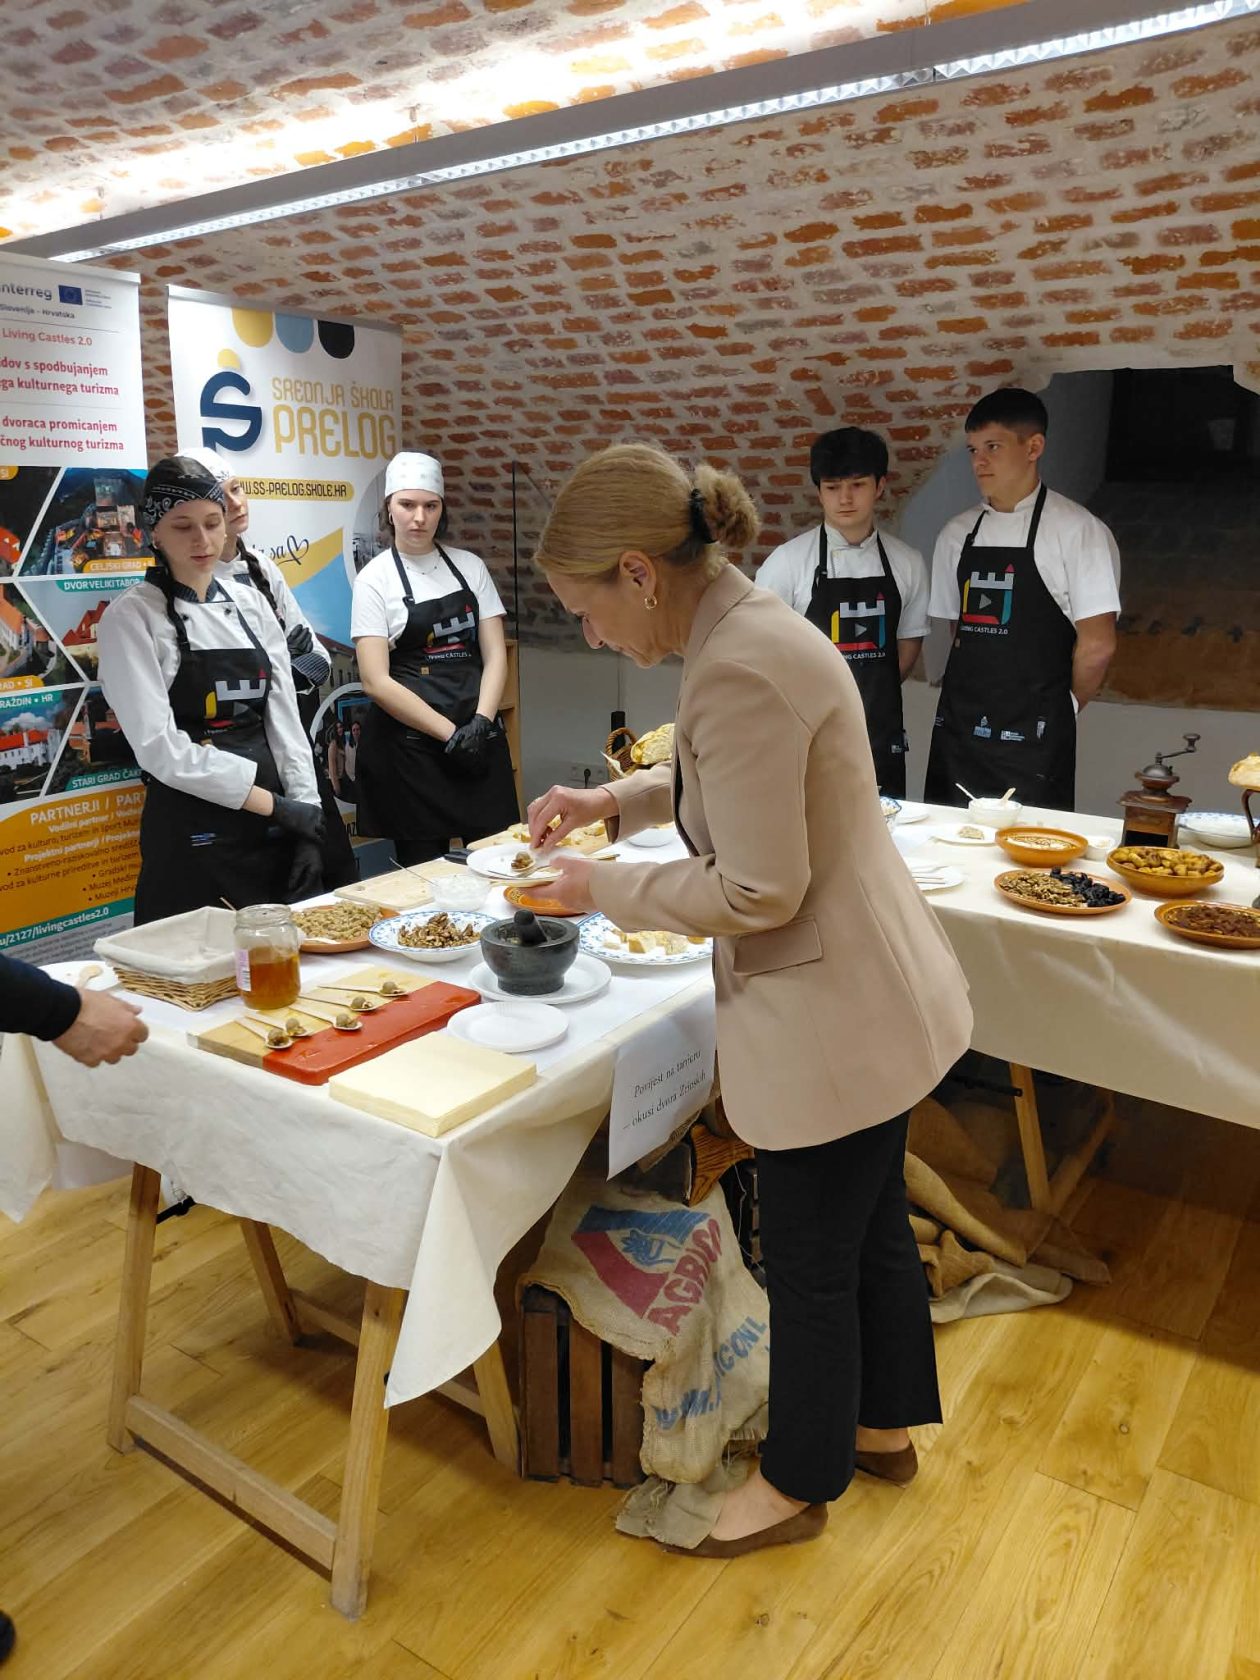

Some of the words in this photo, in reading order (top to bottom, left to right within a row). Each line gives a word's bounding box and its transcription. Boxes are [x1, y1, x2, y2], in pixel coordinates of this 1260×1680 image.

[42, 308, 75, 319] Hrvatska
[3, 329, 35, 342] Living
[38, 332, 75, 345] Castles
[78, 335, 93, 346] 2.0
[0, 357, 21, 369] dov
[25, 361, 30, 369] s
[33, 361, 108, 378] spodbujanjem
[17, 377, 78, 396] kulturnega
[80, 383, 119, 395] turizma
[271, 377, 345, 406] SREDNJA
[3, 416, 46, 429] dvoraca
[49, 418, 117, 435] promicanjem
[273, 404, 397, 460] PRELOG
[29, 436, 83, 452] kulturnog
[86, 440, 124, 451] turizma
[64, 582, 89, 591] DVOR
[89, 580, 115, 589] VELIKI
[974, 626, 997, 634] CASTLES
[42, 694, 53, 702] HR
[72, 776, 96, 789] STARI
[99, 772, 121, 784] GRAD
[30, 799, 100, 826] PARTNERJI
[666, 1067, 675, 1080] na
[632, 1105, 655, 1127] okusi
[656, 1092, 677, 1112] dvora
